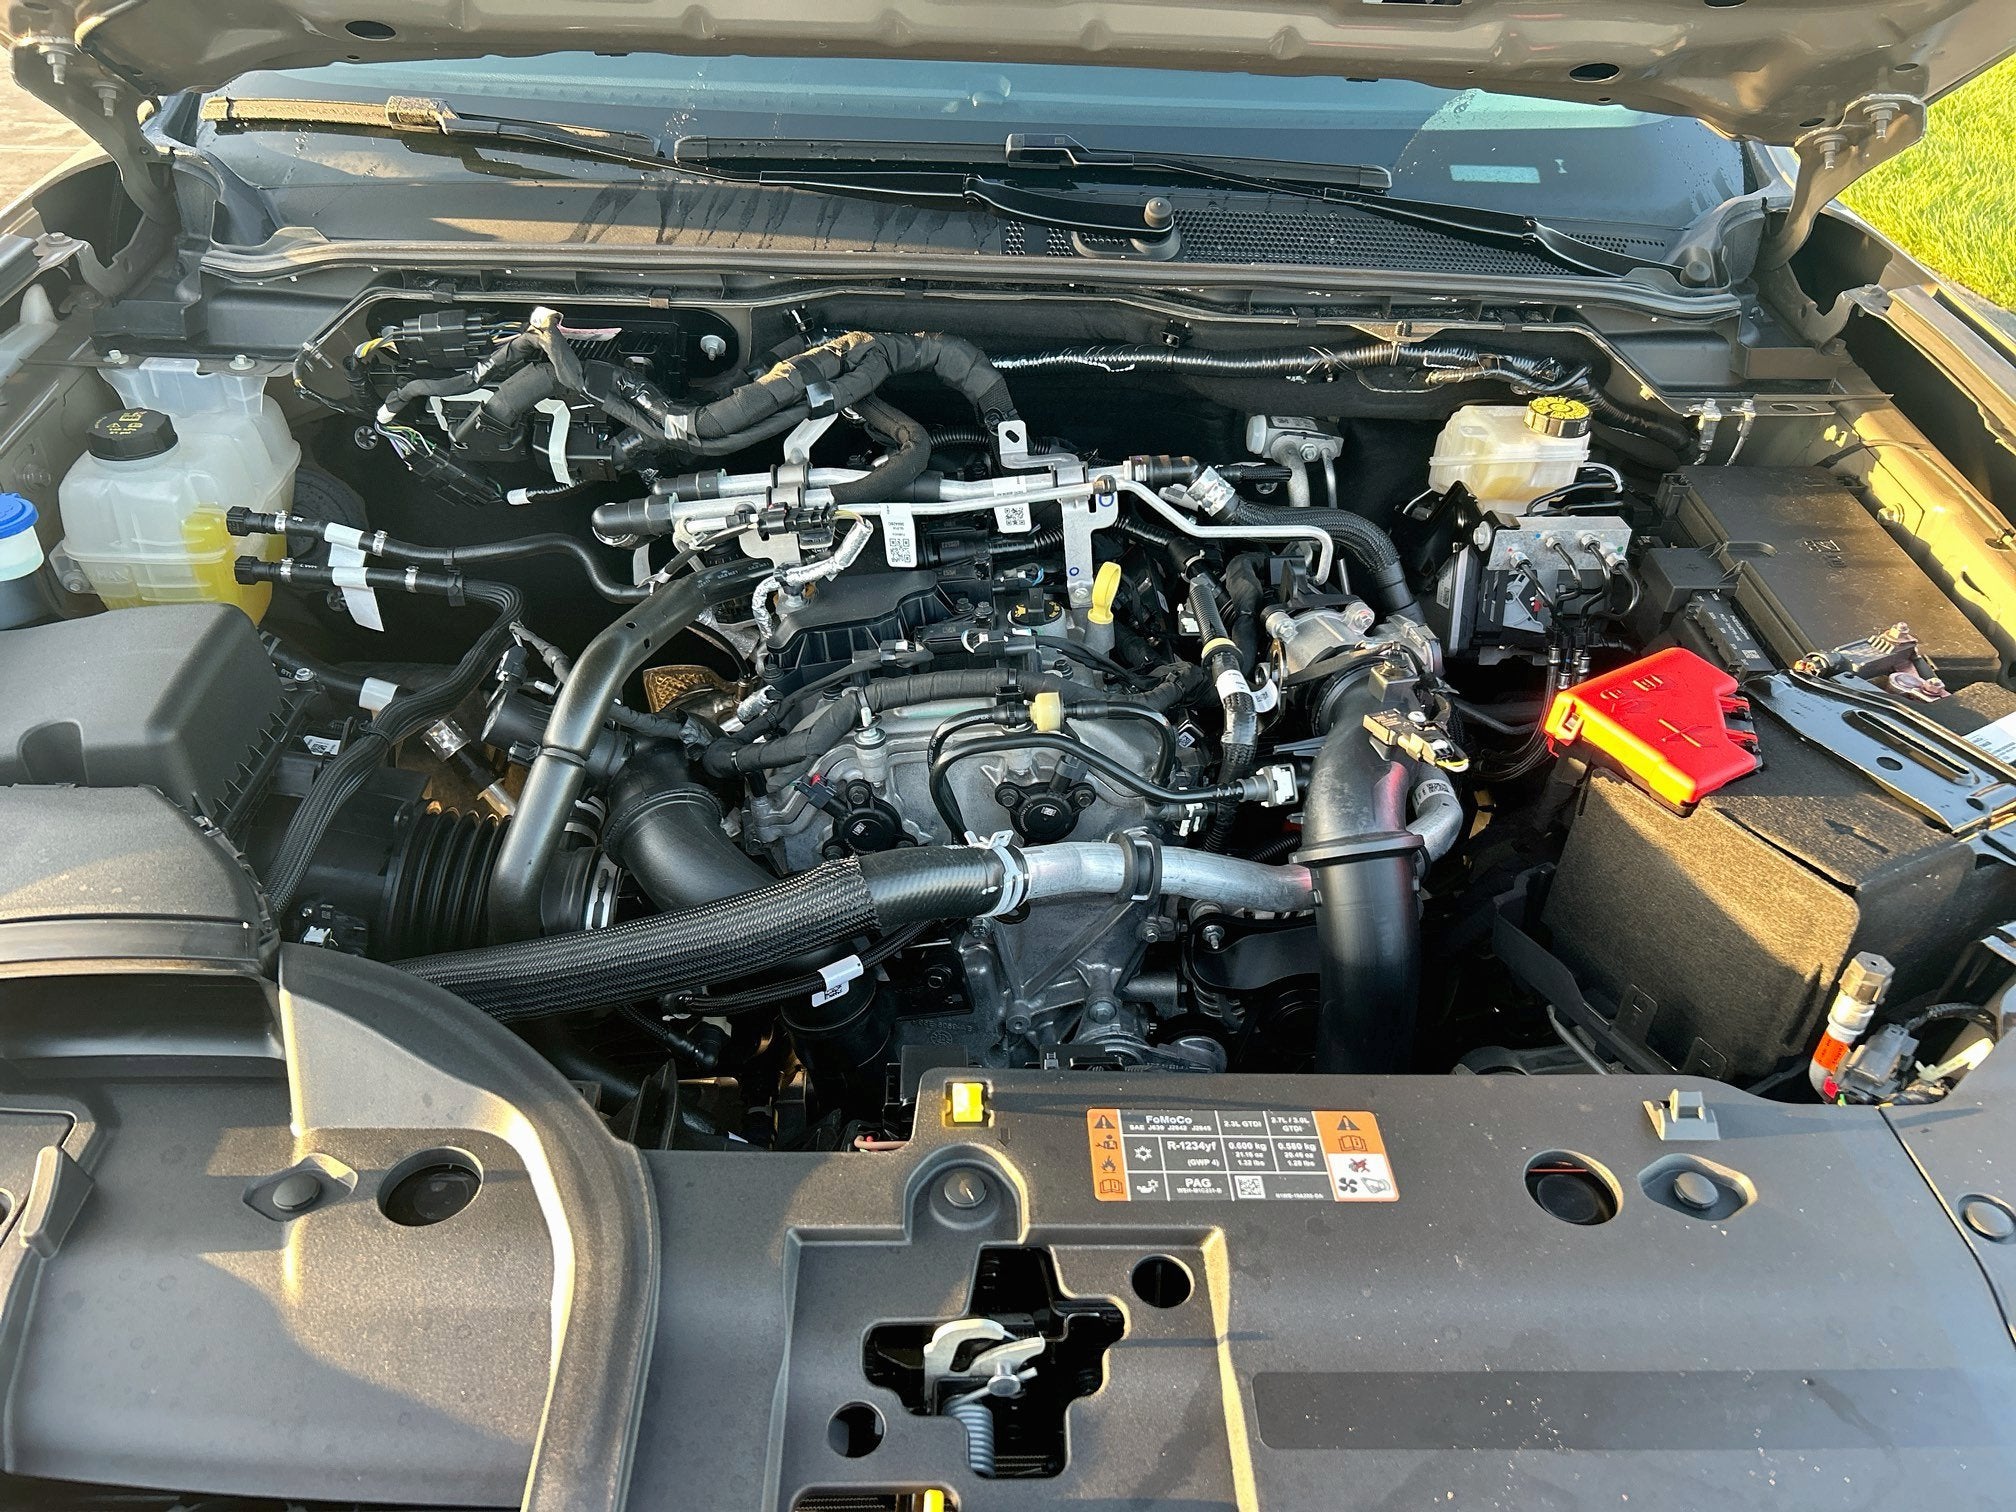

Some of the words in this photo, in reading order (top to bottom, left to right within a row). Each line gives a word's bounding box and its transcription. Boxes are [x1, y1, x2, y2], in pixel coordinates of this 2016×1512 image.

[1145, 1115, 1193, 1124] FoMoCo
[1223, 1120, 1241, 1128] 2.3L
[1270, 1116, 1288, 1124] 2.7L
[1166, 1140, 1217, 1153] R-1234yf
[1228, 1141, 1254, 1150] 0.600
[1254, 1141, 1267, 1152] kg
[1277, 1142, 1303, 1151] 0.580
[1303, 1142, 1317, 1152] kg
[1187, 1158, 1211, 1167] (GWP
[1211, 1159, 1220, 1167] 4)
[1184, 1178, 1212, 1188] PAG
